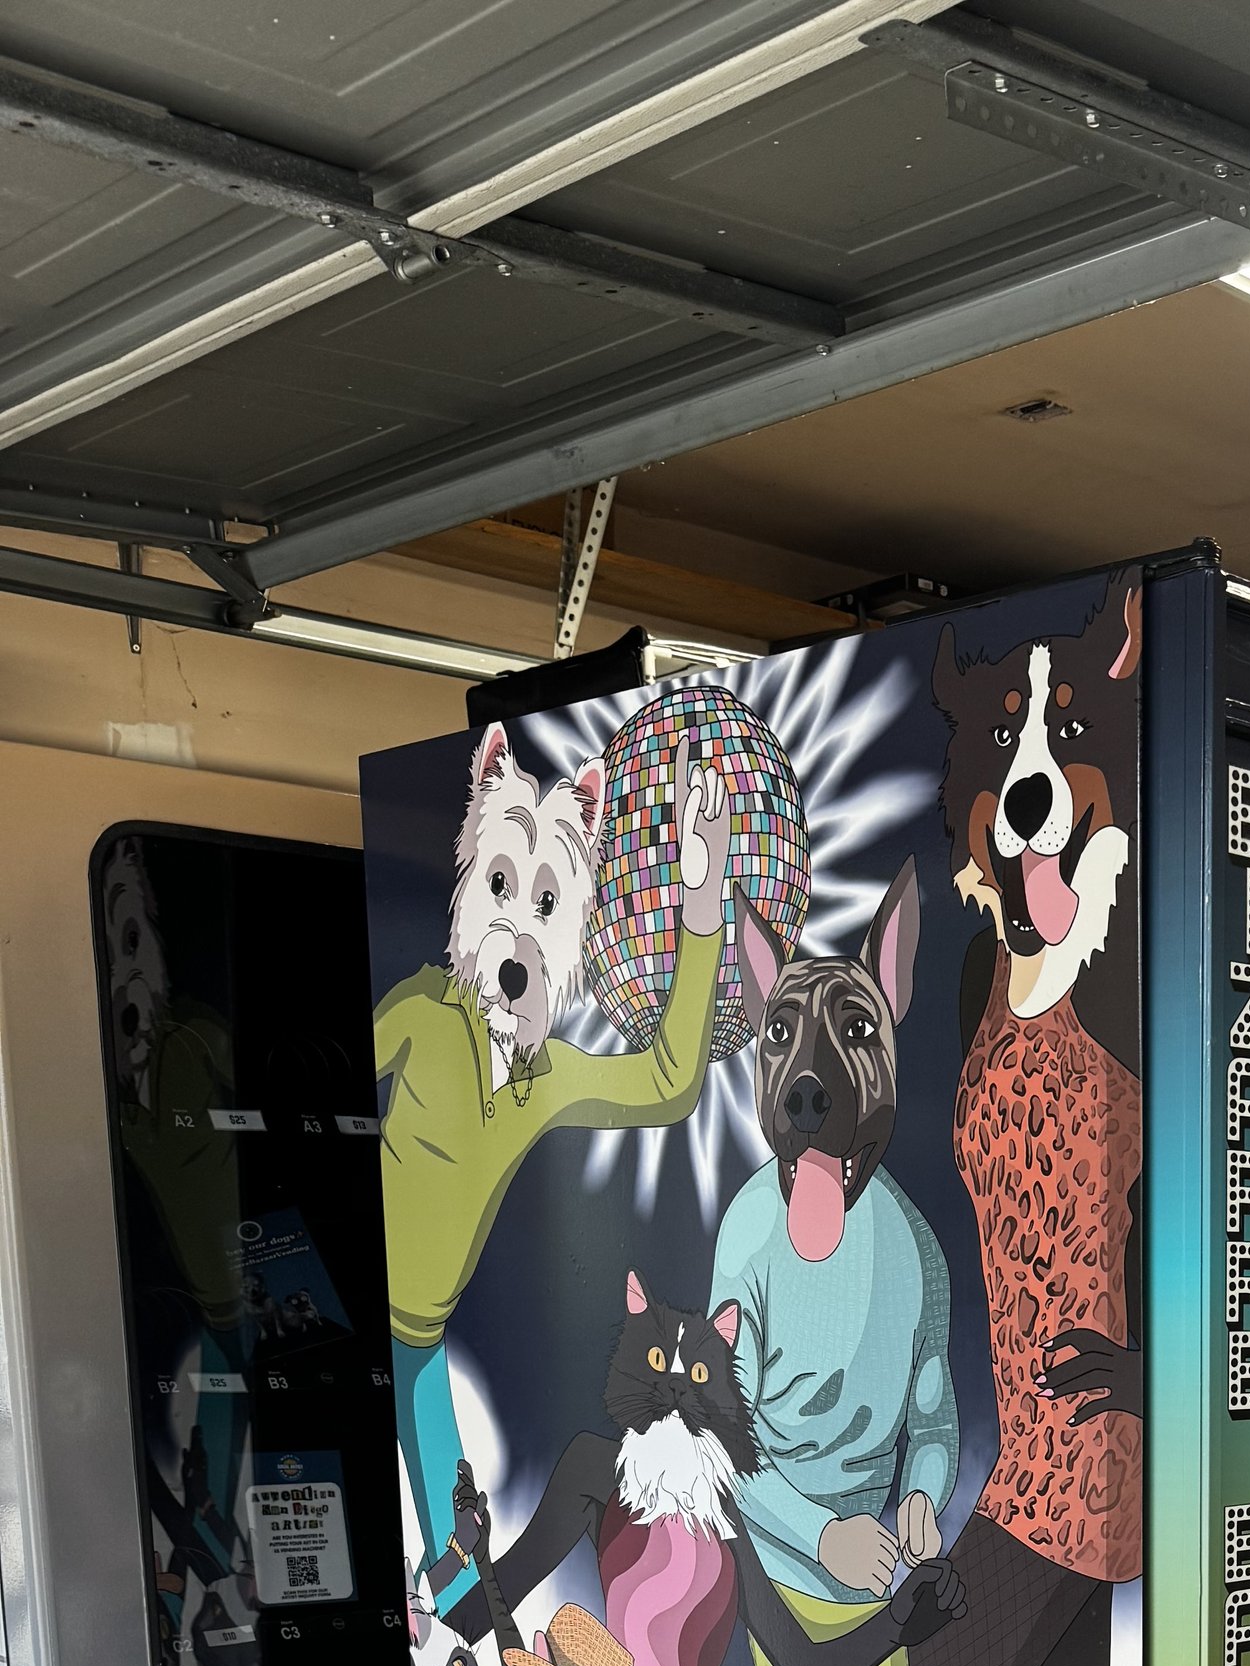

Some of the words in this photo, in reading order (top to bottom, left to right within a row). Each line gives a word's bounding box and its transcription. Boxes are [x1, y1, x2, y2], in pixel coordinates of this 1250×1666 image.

[175, 1115, 195, 1128] A2
[304, 1120, 322, 1133] A3
[268, 1376, 289, 1389] B3
[371, 1373, 391, 1386] B4
[158, 1382, 180, 1394] B2
[382, 1614, 402, 1627] C4
[280, 1625, 301, 1640] C3
[172, 1639, 193, 1653] C2
